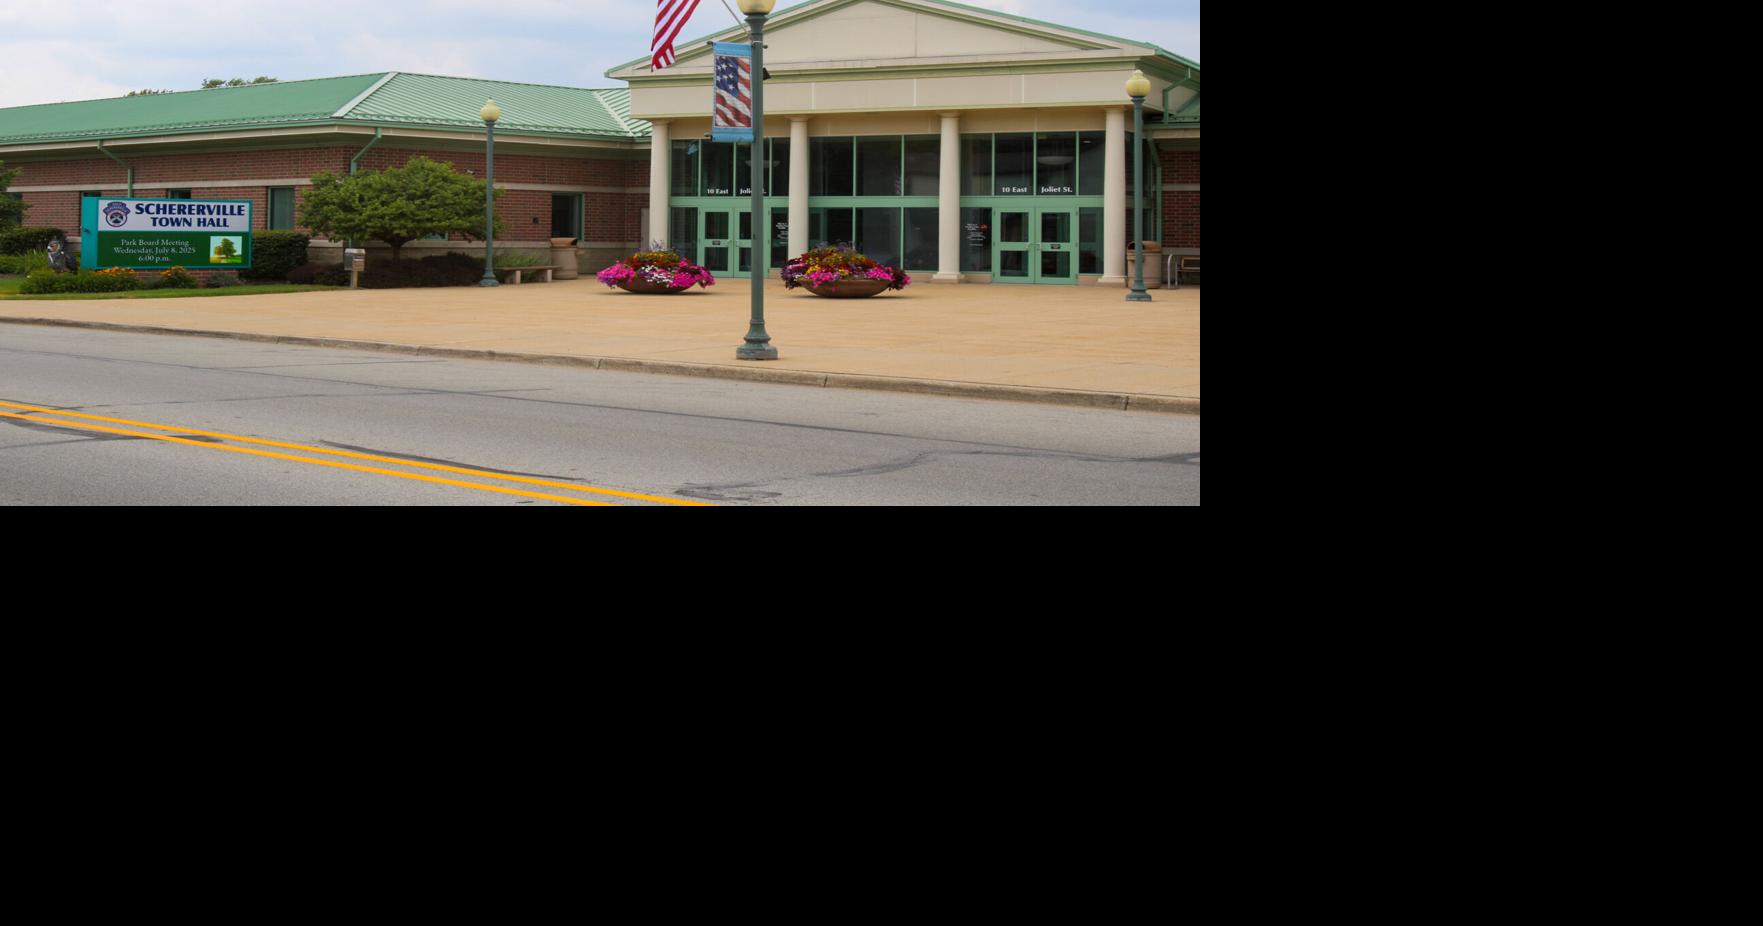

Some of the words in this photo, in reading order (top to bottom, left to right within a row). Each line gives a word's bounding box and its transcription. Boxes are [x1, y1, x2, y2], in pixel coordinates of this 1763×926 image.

[135, 203, 245, 216] SCHERERVILLE
[150, 217, 192, 227] TOWN
[197, 218, 229, 227] HALL
[160, 239, 189, 248] Meeting
[154, 247, 170, 256] July
[155, 256, 170, 264] p.m.
